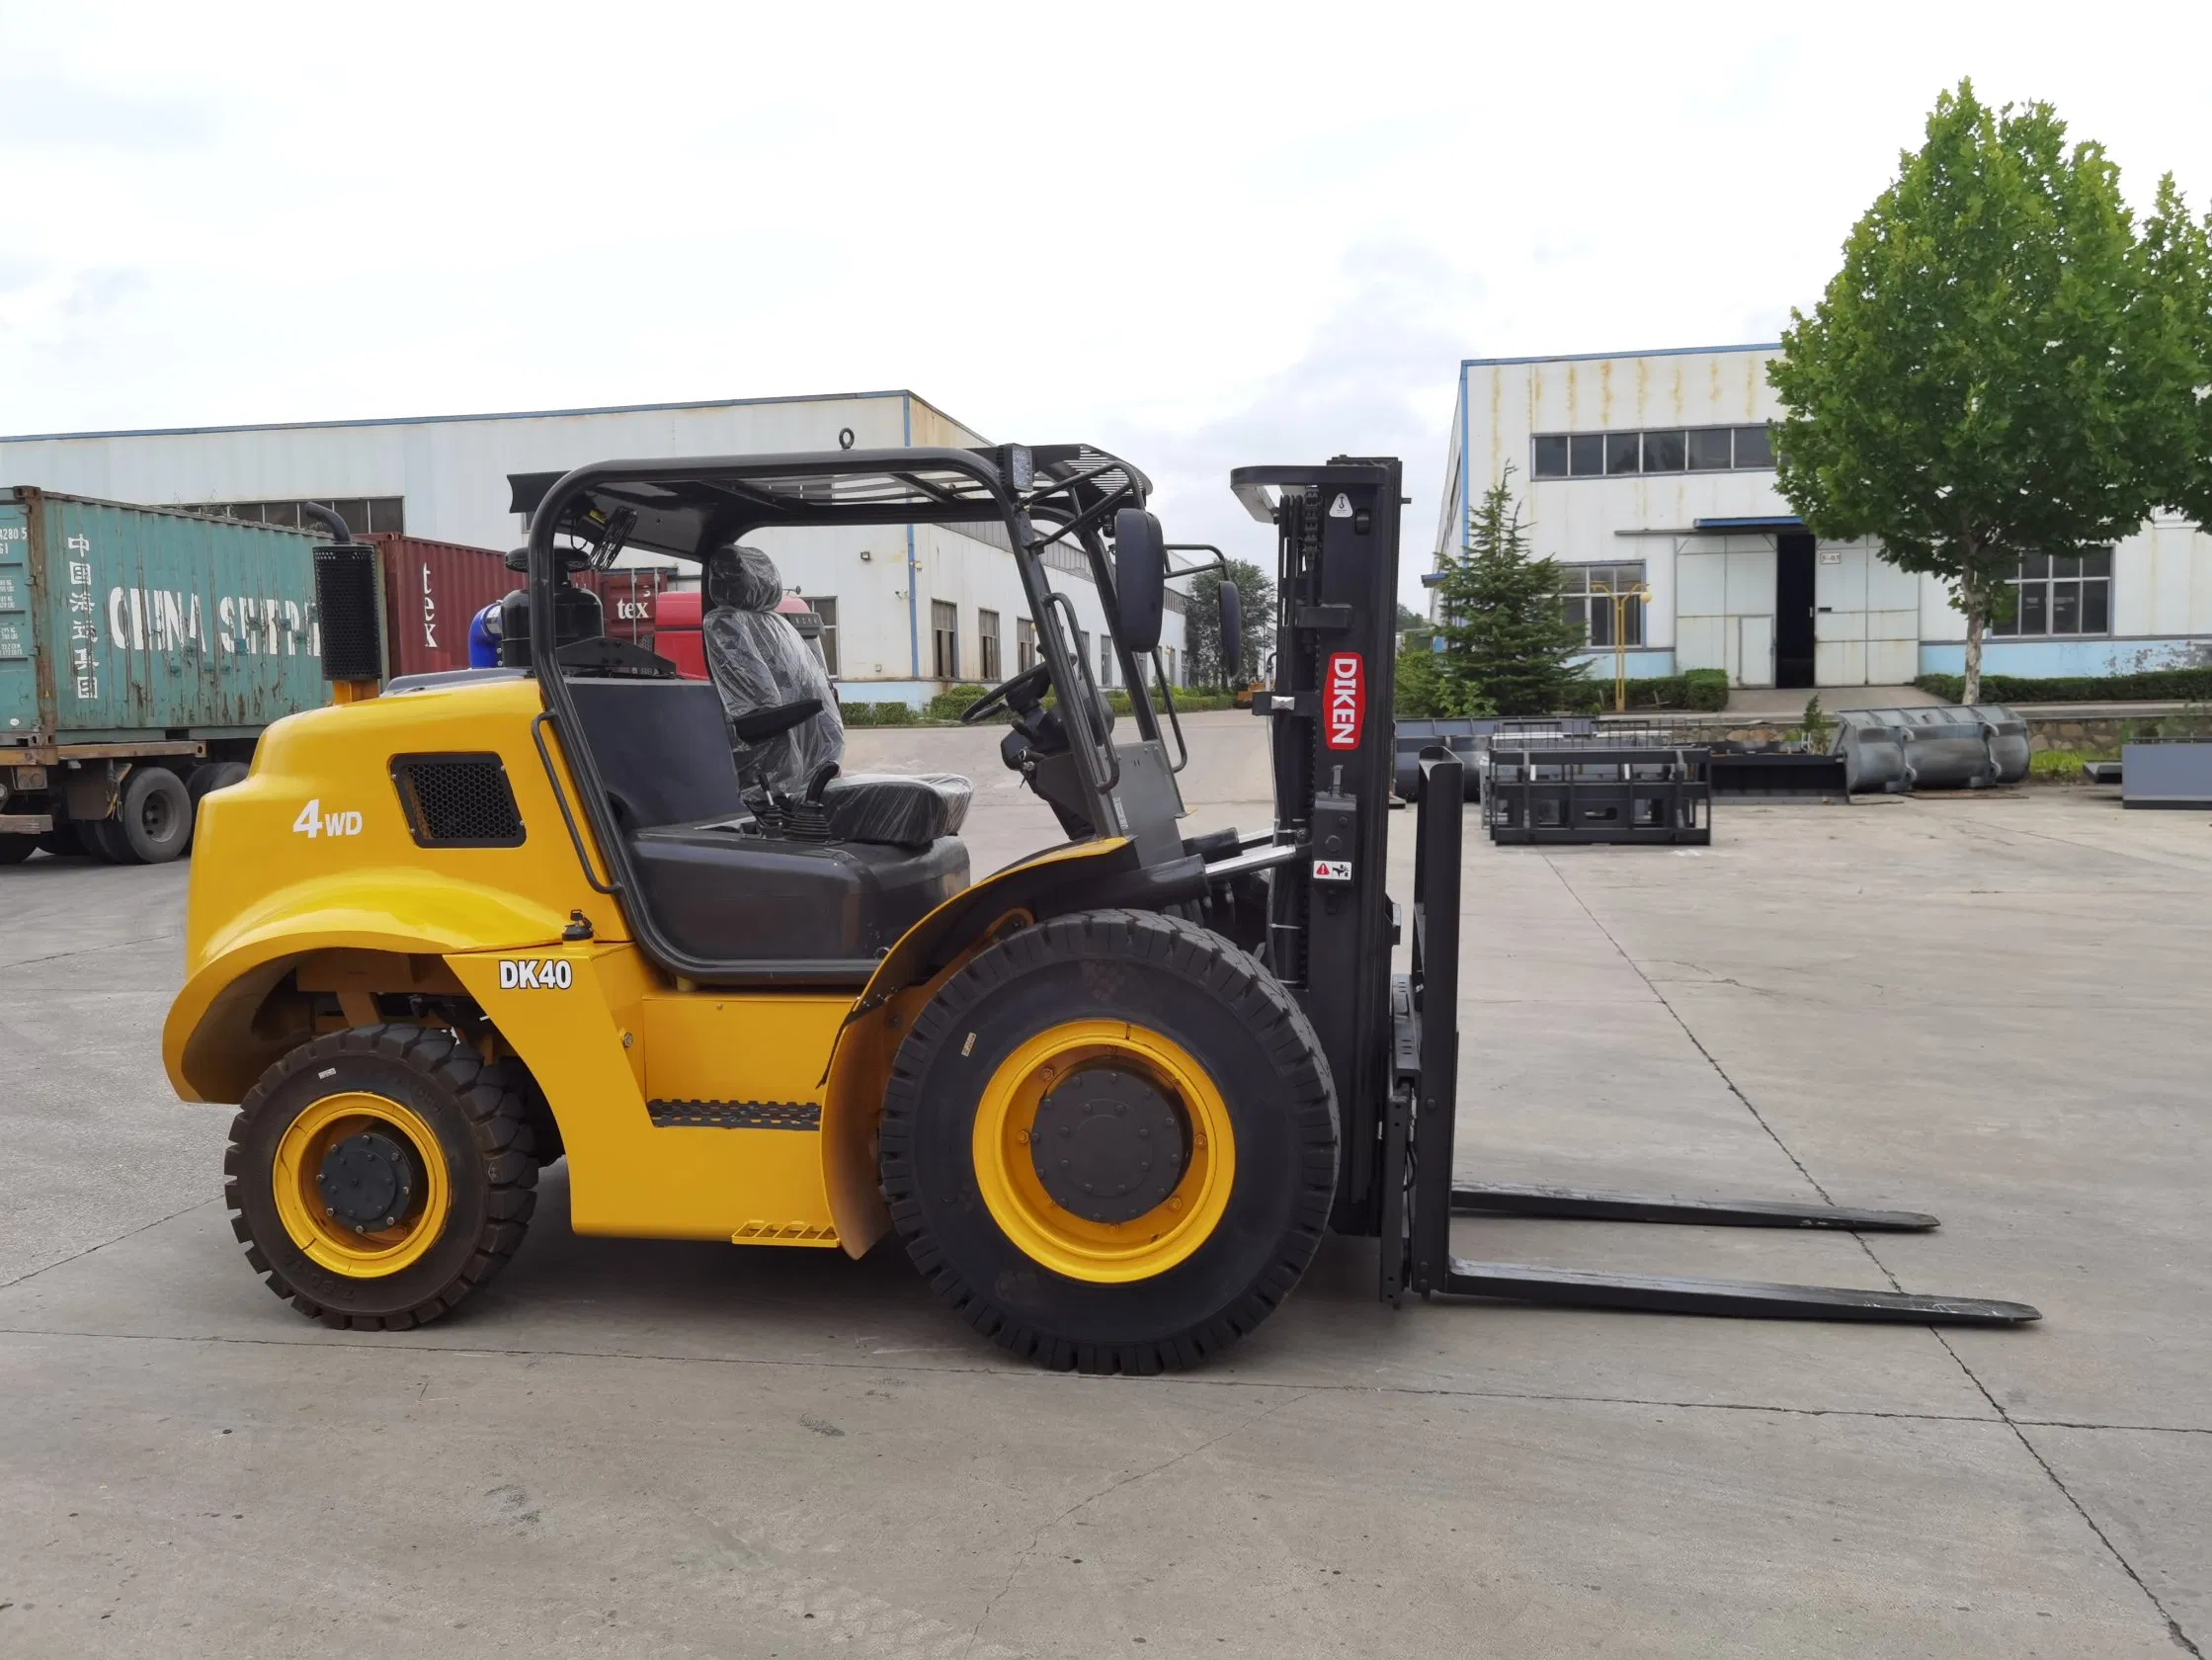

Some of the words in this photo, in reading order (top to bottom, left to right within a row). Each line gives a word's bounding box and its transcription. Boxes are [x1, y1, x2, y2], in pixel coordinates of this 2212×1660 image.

[109, 586, 206, 653] CHINA
[423, 562, 438, 648] tex
[616, 598, 649, 620] tex
[1332, 658, 1356, 744] DIKEN
[292, 798, 363, 838] 4WD
[499, 959, 572, 989] DK40
